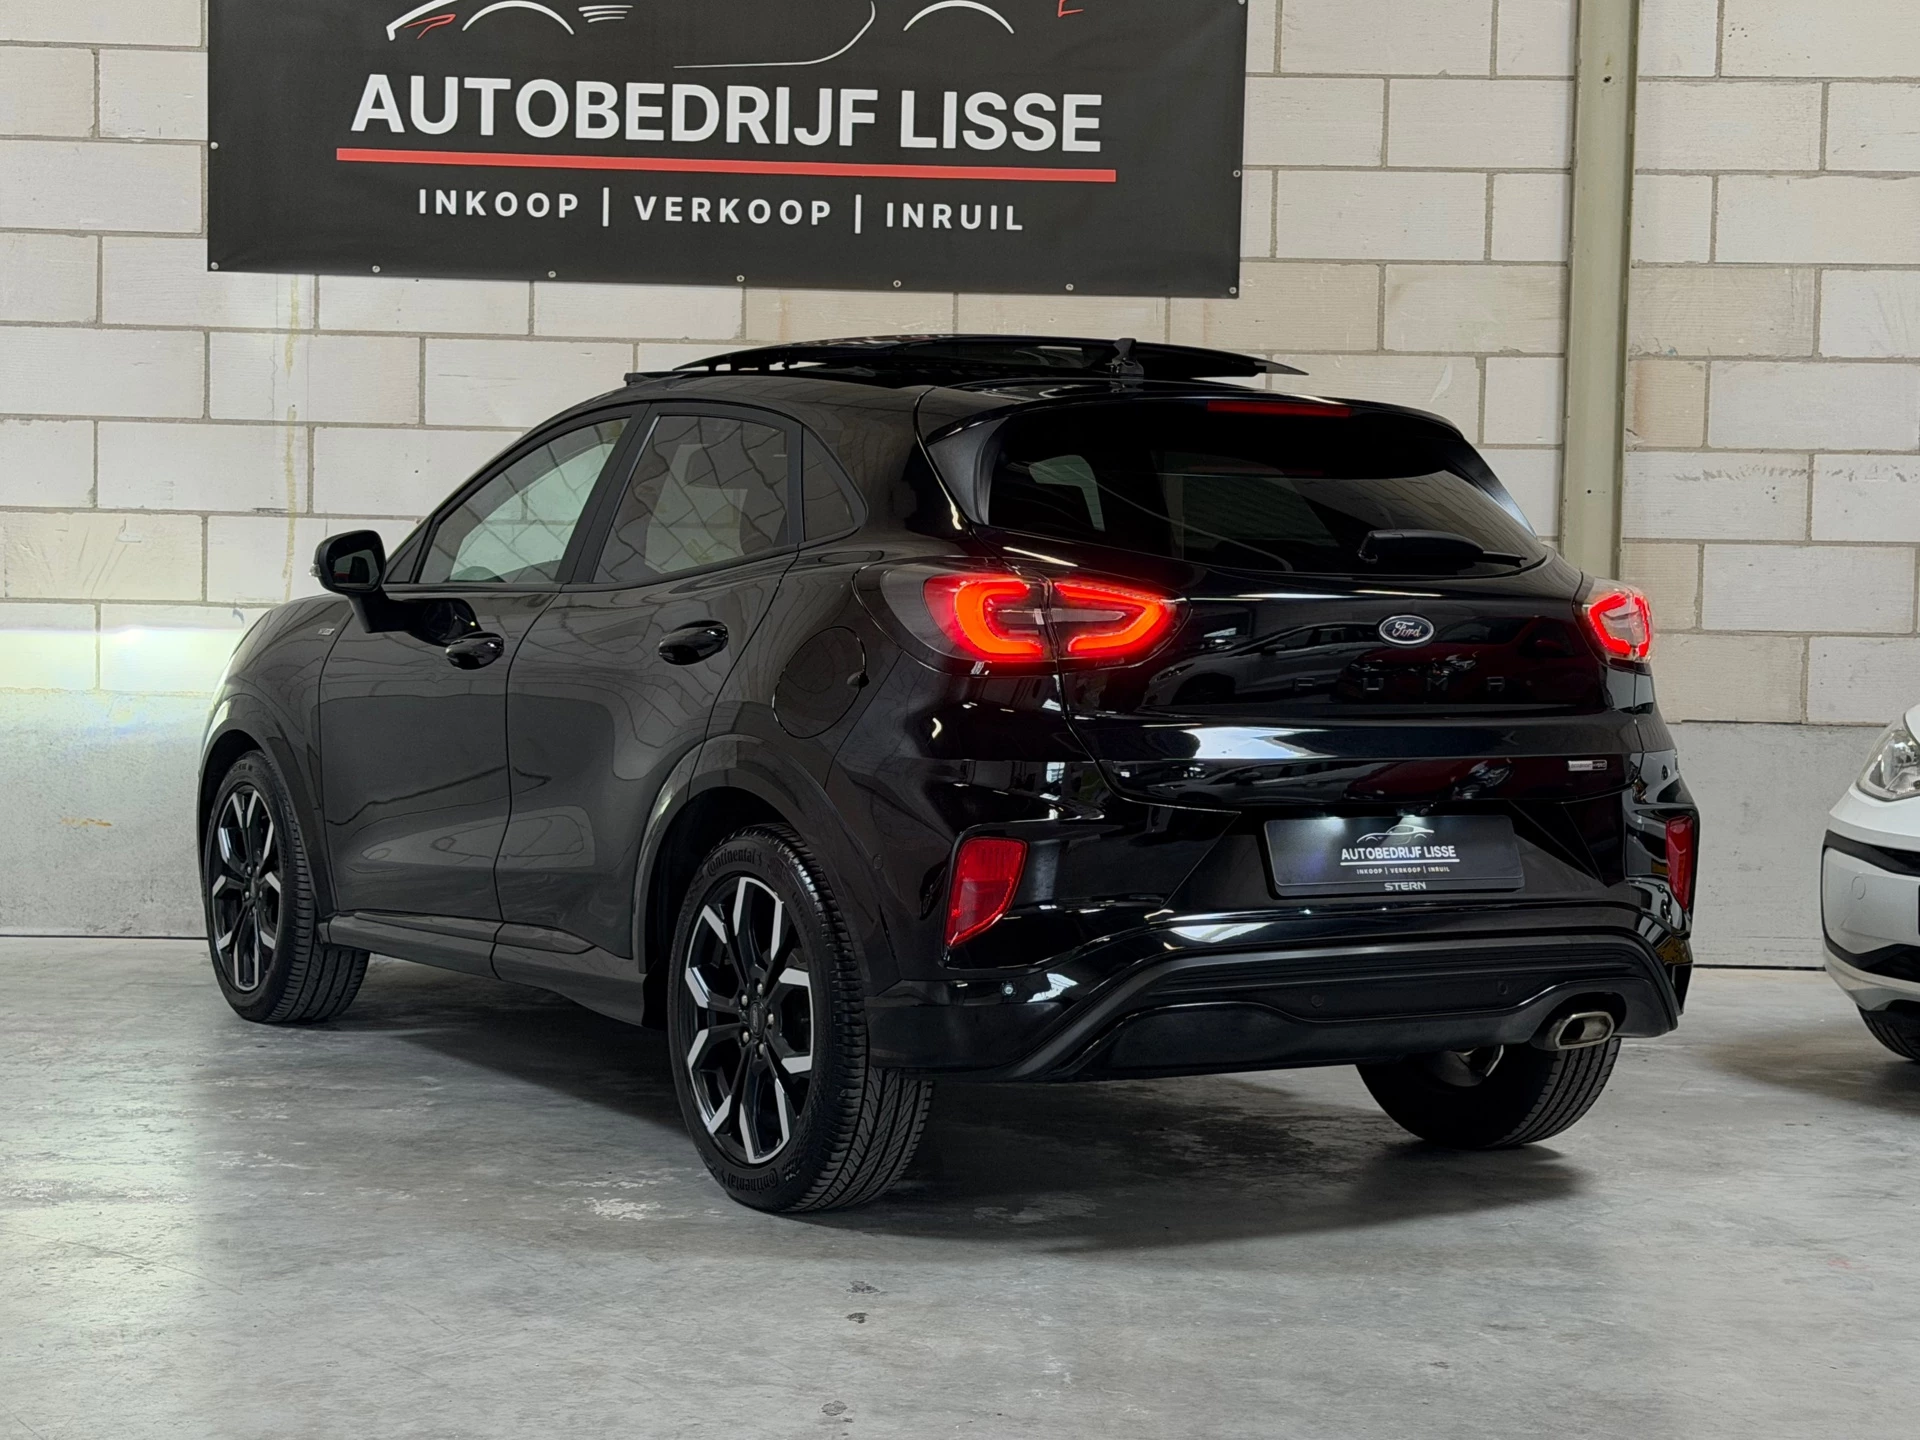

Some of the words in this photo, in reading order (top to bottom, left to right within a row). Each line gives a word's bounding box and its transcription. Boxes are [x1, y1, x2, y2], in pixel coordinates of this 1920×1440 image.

[350, 73, 879, 147] AUTOBEDRIJF
[900, 89, 1102, 153] LISSE
[419, 188, 578, 219] INKOOP
[633, 195, 831, 226] VERKOOP
[886, 202, 1023, 231] INRUIL
[1391, 620, 1422, 638] Ford
[706, 848, 757, 877] Continental
[1341, 846, 1422, 860] AUTOBEDRIJF
[1424, 845, 1457, 858] LISSE
[1384, 881, 1427, 891] STERN
